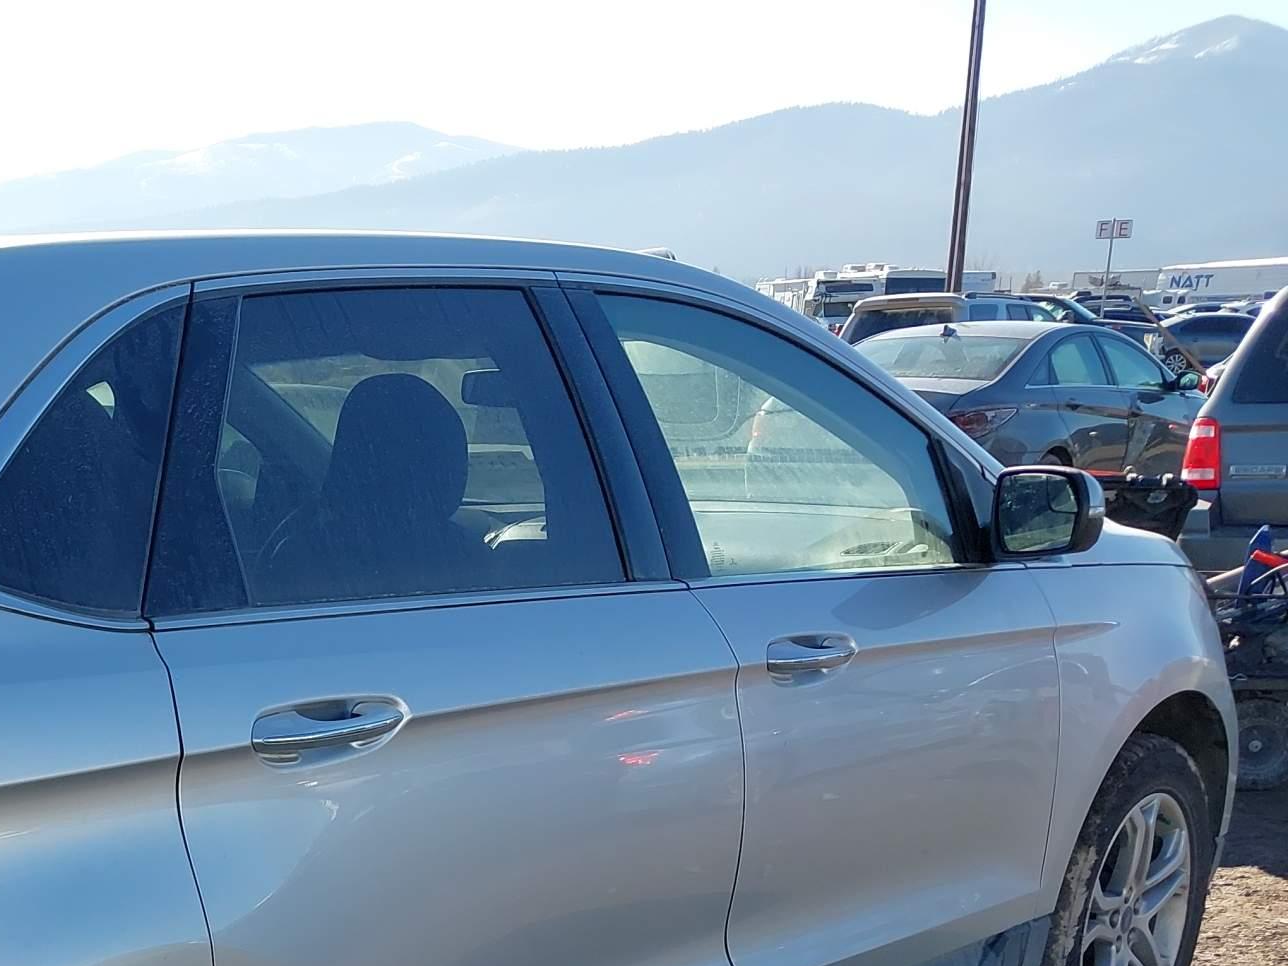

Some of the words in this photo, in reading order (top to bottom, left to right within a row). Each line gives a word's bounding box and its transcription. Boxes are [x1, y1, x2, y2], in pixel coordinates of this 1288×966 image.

[1099, 222, 1110, 237] F
[1119, 222, 1129, 237] E
[1169, 274, 1215, 292] NATT
